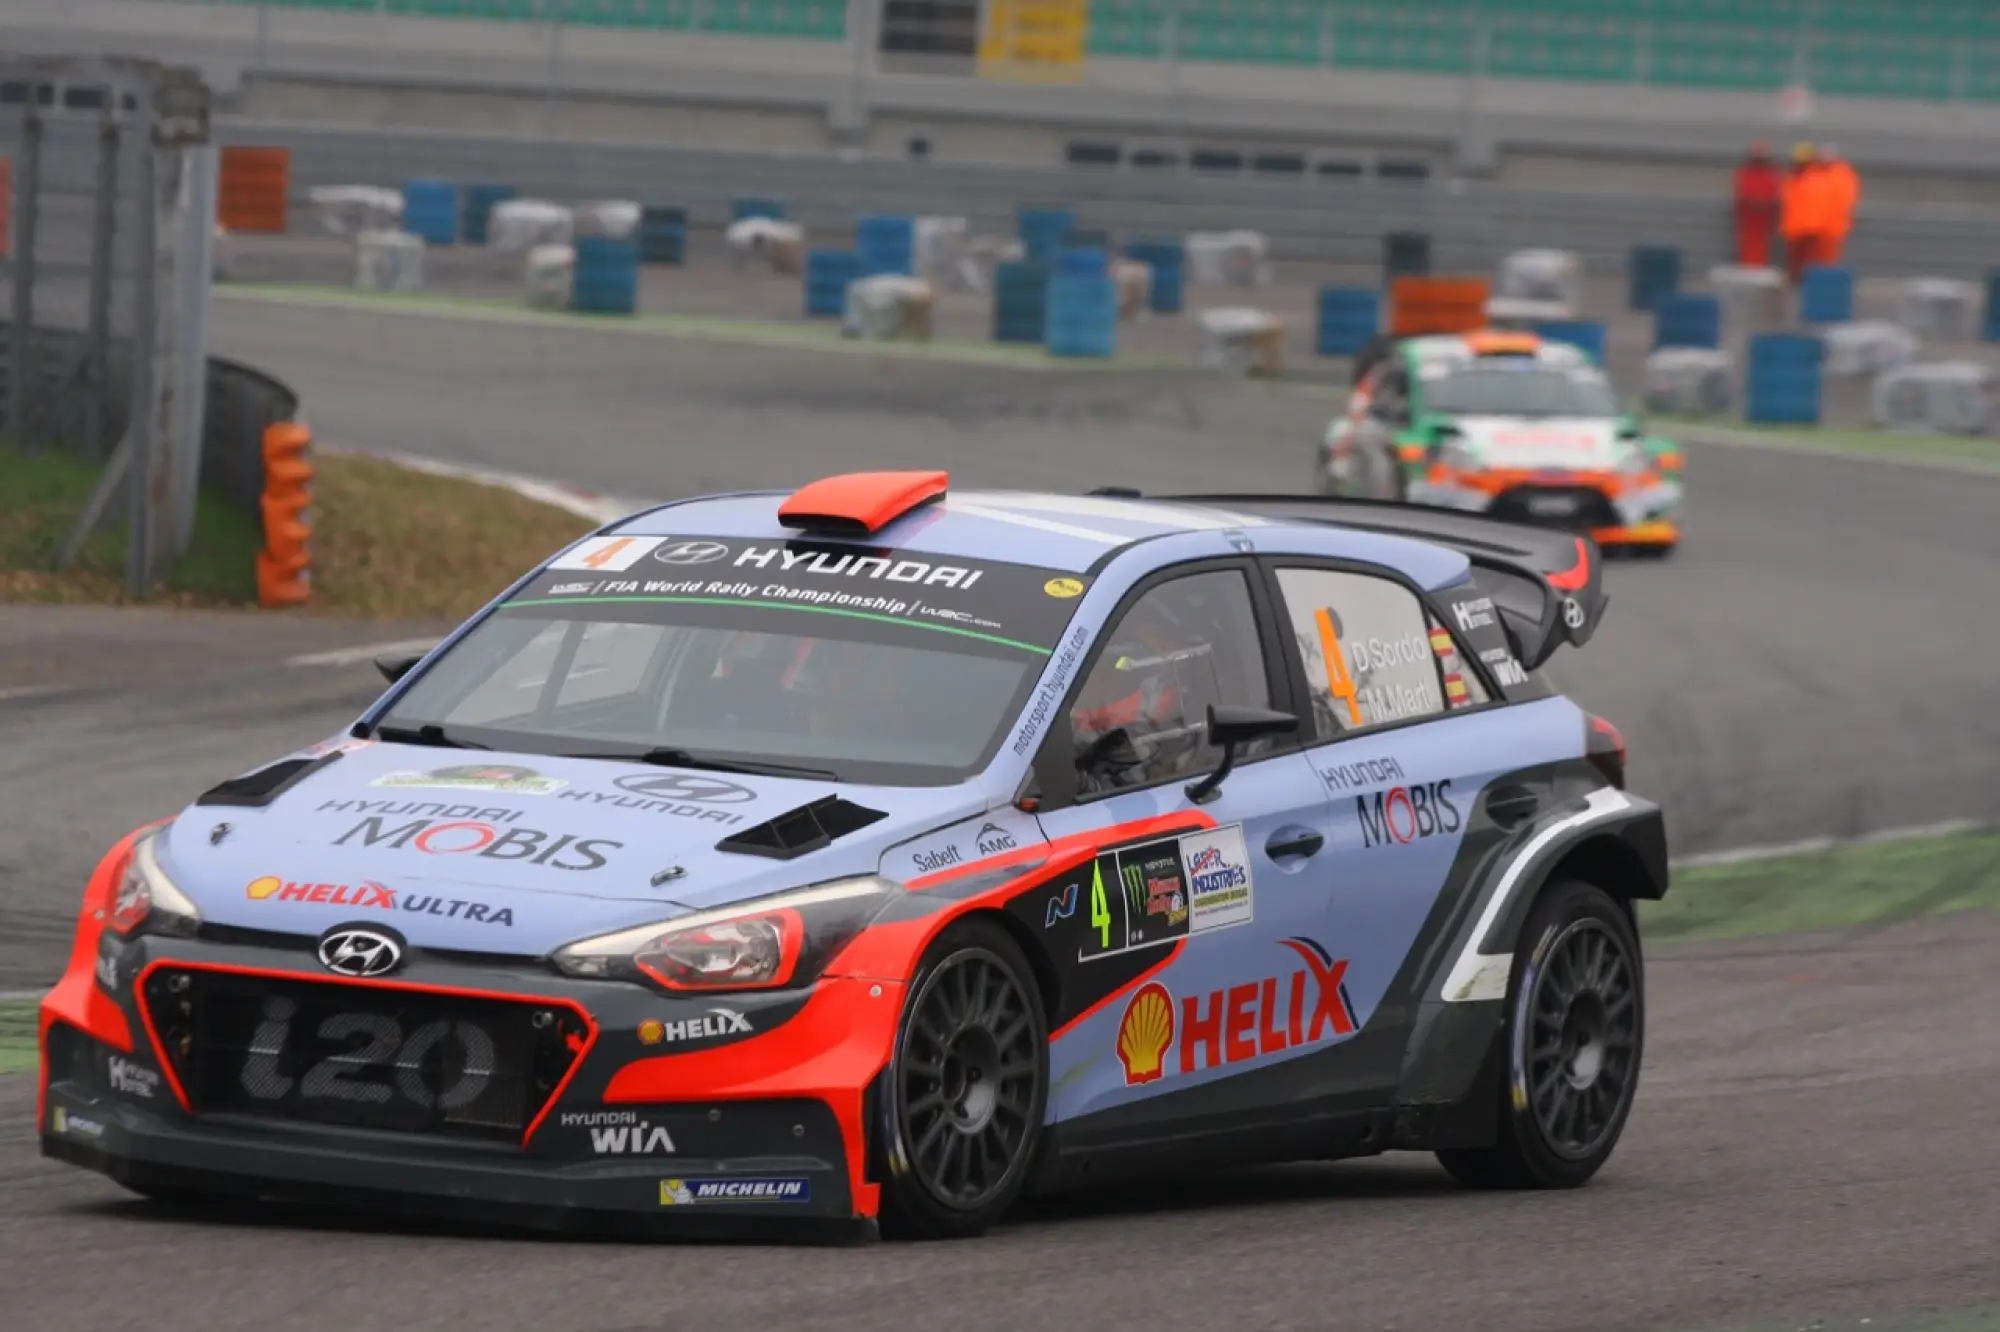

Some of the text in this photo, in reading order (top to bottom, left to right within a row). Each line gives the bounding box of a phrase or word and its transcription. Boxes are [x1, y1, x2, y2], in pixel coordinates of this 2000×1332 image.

[733, 547, 983, 590] HYUNDAI
[603, 580, 638, 593] FIA
[643, 580, 703, 593] World
[704, 581, 757, 597] Rally
[761, 584, 906, 614] Championship
[1314, 608, 1358, 726] 4
[1013, 625, 1089, 757] motorsport.hyundai.com
[1319, 756, 1405, 792] HYUNDAI
[315, 799, 525, 822] HYUNDAI
[556, 789, 744, 825] HYUNDAI
[1356, 778, 1460, 849] MOBIS
[330, 816, 624, 870] MOBIS
[279, 880, 514, 927] HELIX ULTRA
[1091, 858, 1111, 948] 4
[664, 1008, 753, 1042] HELIX
[1180, 936, 1360, 1074] HELIX
[240, 995, 495, 1110] i20
[561, 1111, 636, 1126] HYUNDAI
[590, 1120, 676, 1153] WIA
[697, 1182, 801, 1197] MICHELIN
